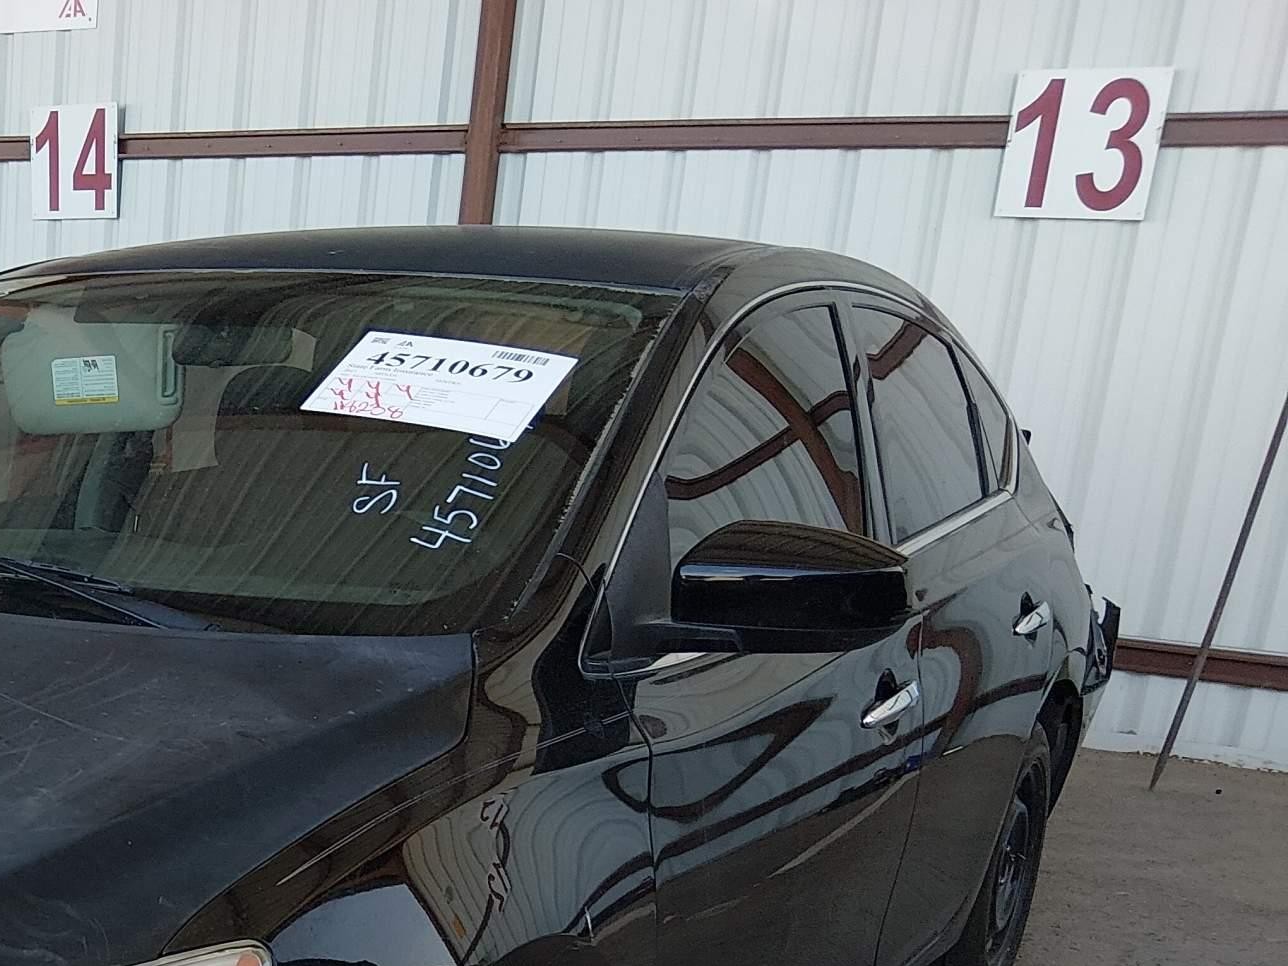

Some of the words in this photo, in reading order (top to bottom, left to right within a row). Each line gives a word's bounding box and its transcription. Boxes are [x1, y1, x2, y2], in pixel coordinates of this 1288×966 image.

[35, 108, 112, 211] 14
[1014, 77, 1151, 212] 13
[366, 350, 535, 384] 45710679
[352, 462, 401, 515] SF
